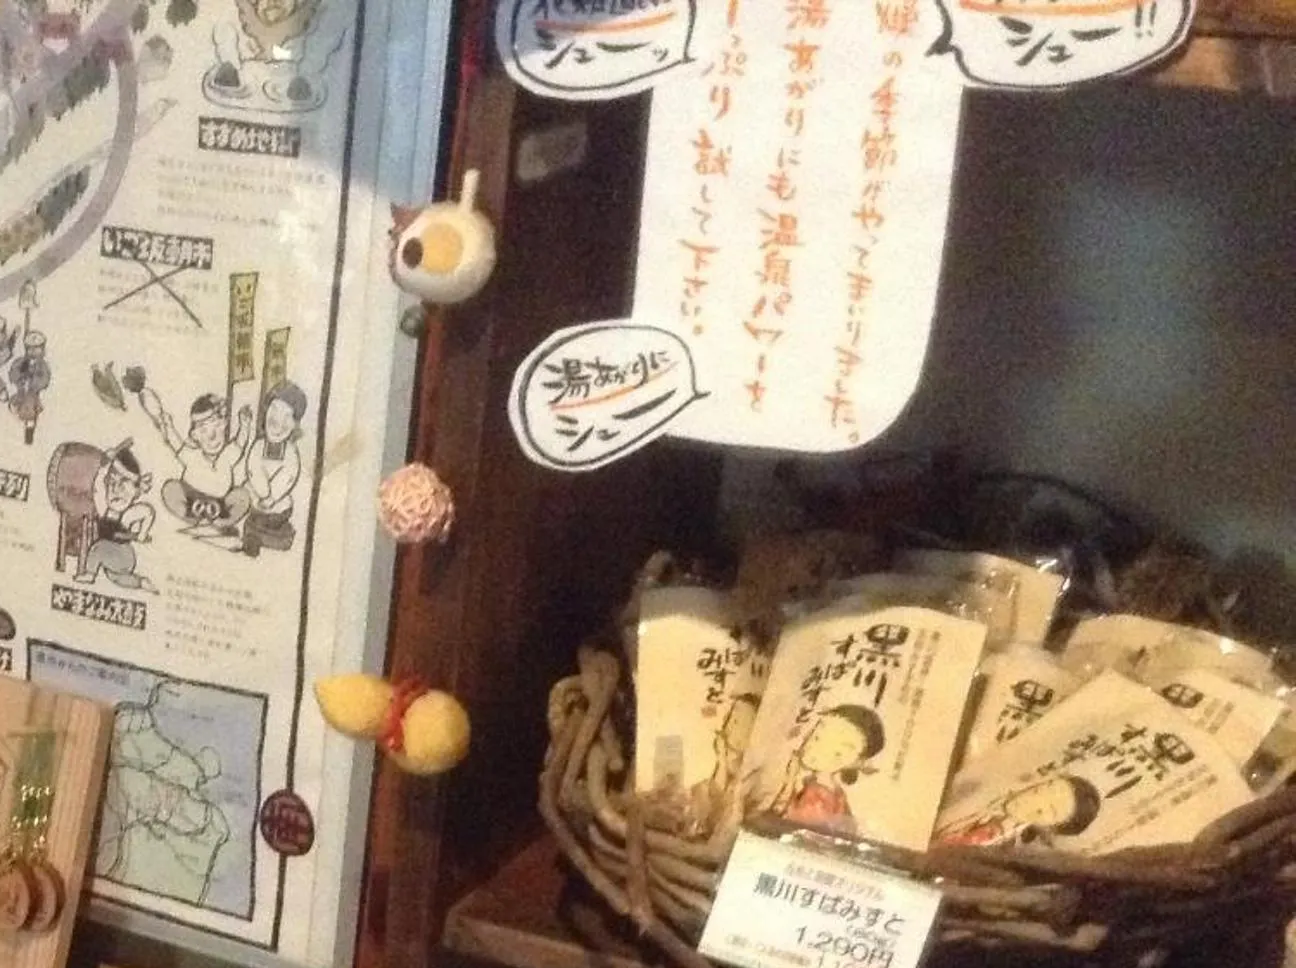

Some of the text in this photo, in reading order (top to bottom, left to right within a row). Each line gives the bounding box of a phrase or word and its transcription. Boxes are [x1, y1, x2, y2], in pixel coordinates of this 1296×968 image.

[754, 871, 905, 937] 黒川すばみすと
